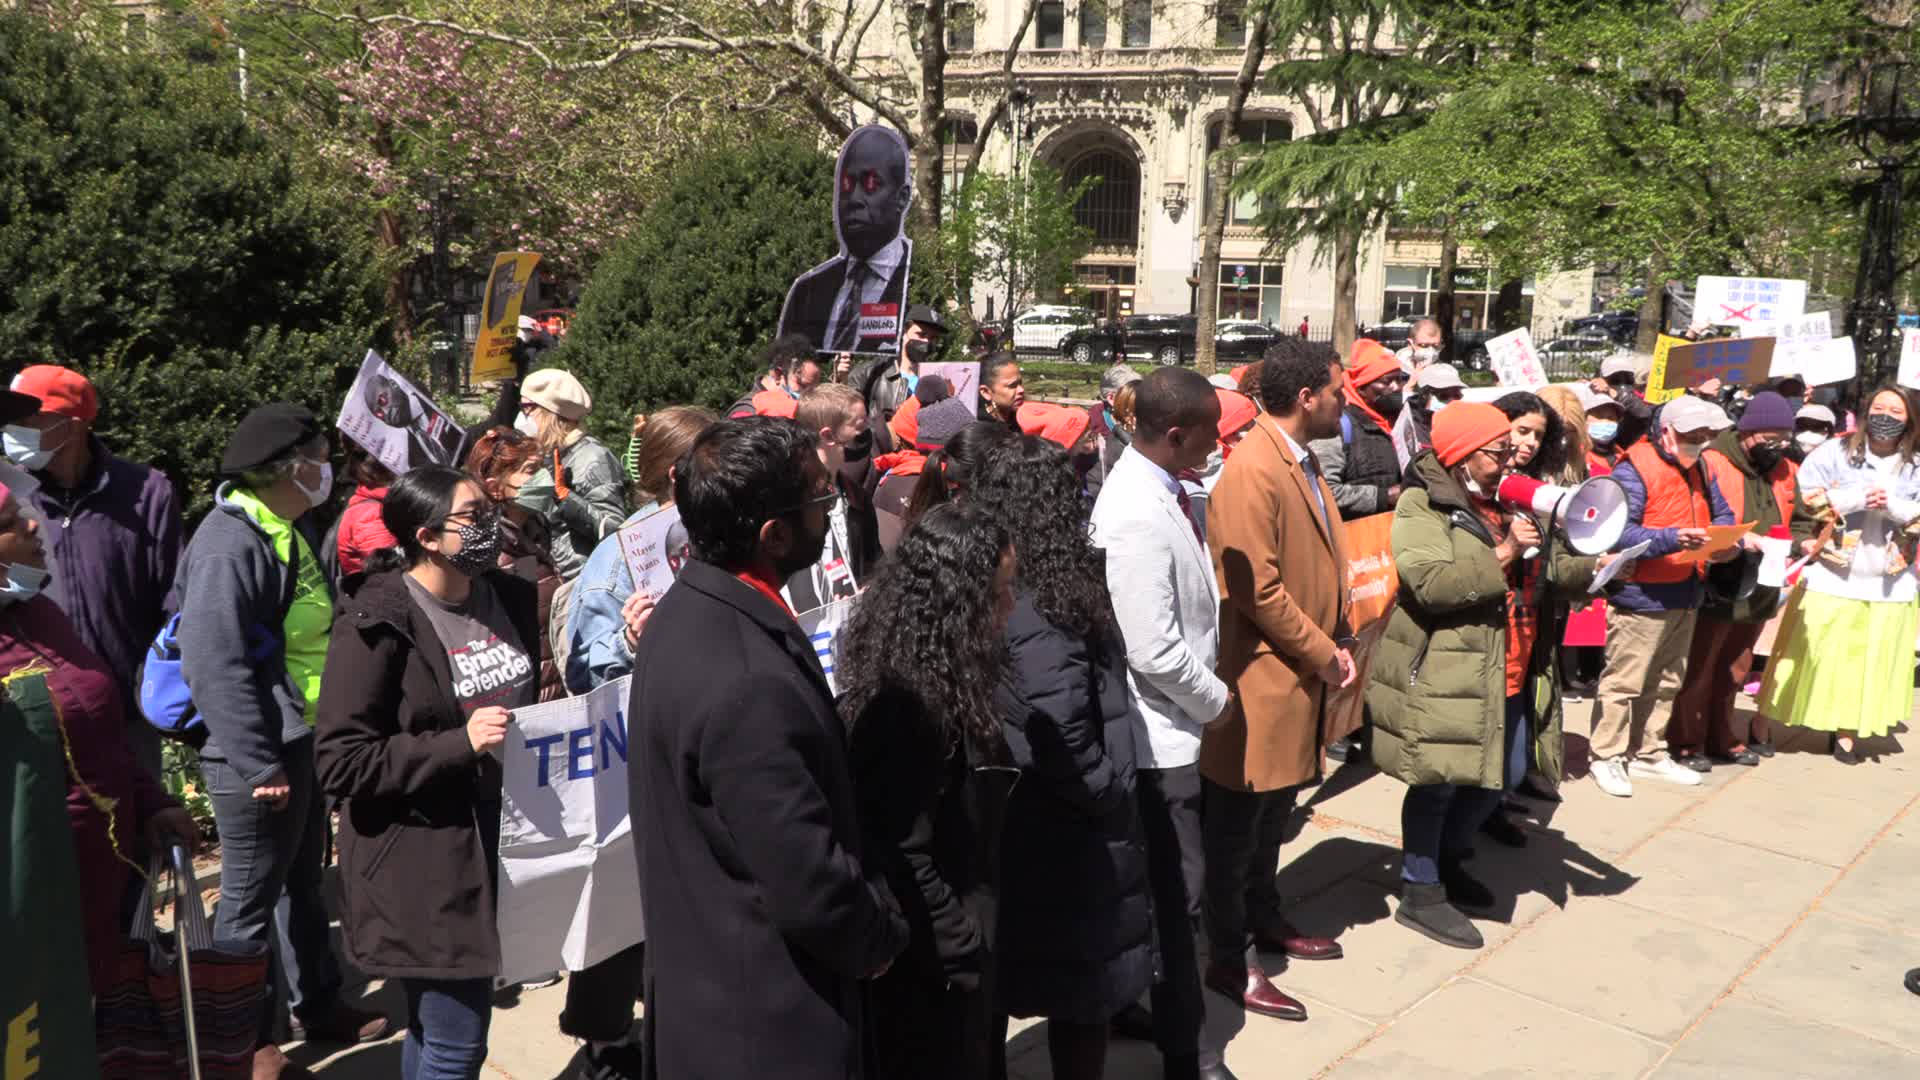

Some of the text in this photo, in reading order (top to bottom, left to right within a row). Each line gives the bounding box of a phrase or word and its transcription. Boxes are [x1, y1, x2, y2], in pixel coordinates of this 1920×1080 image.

[629, 532, 643, 543] The
[632, 542, 657, 557] Mayor
[636, 558, 660, 573] Wants
[467, 640, 488, 652] The
[454, 643, 516, 676] Bronx
